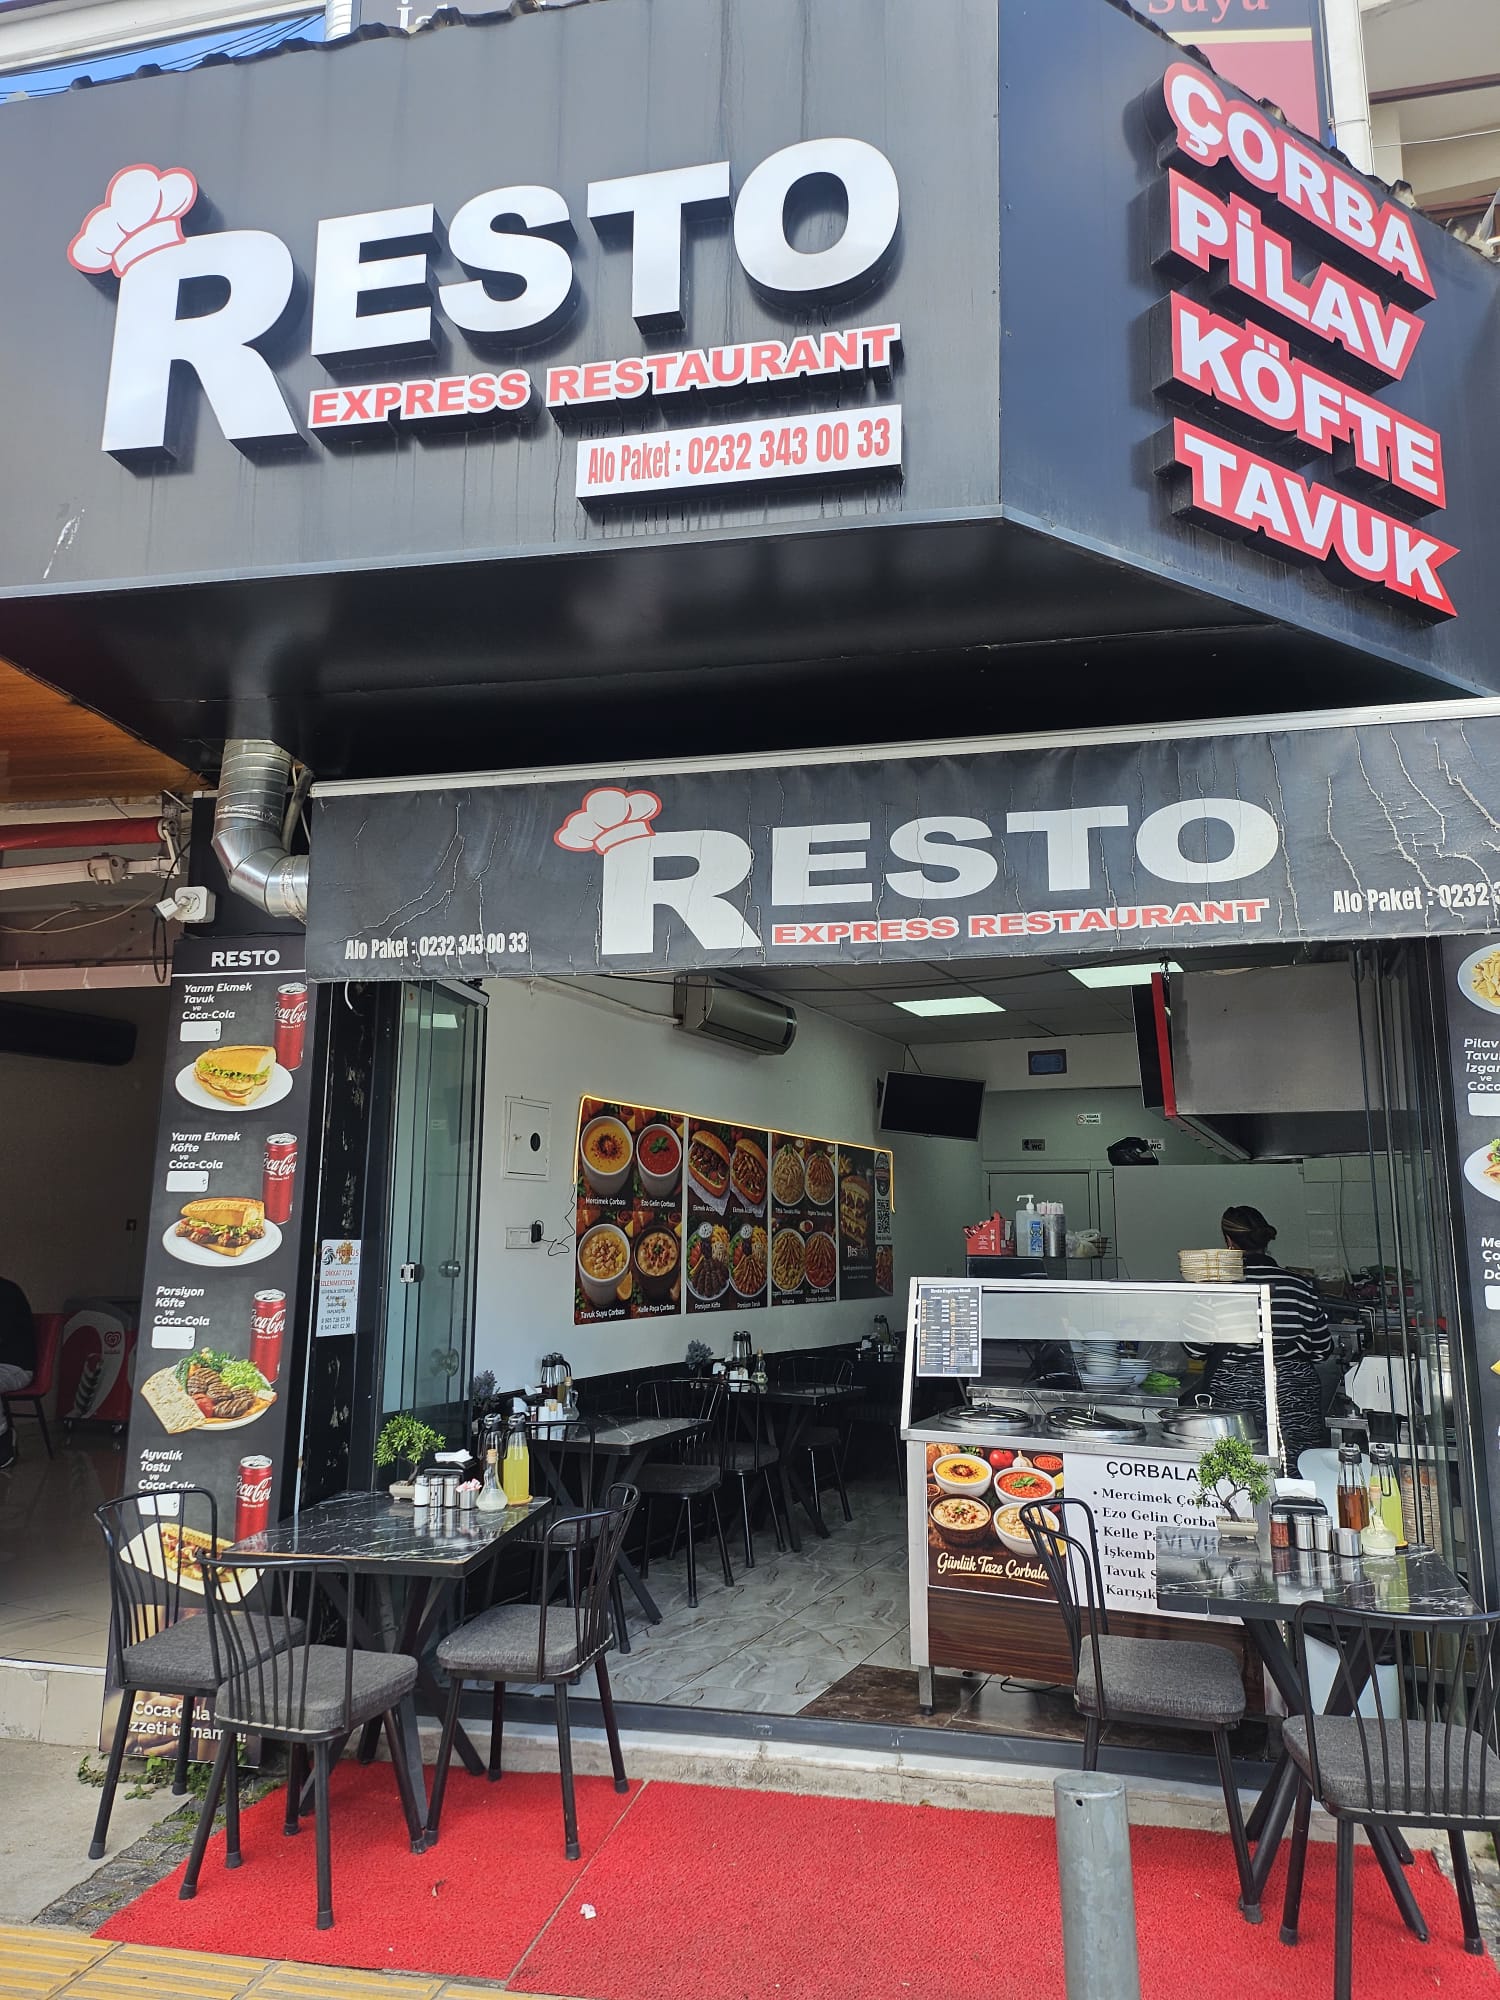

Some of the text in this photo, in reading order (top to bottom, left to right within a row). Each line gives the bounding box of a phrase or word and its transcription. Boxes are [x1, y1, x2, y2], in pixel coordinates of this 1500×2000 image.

[1170, 74, 1425, 284] ÇORBA
[1177, 186, 1412, 371] PİLAV
[102, 138, 900, 453] RESTO
[310, 325, 900, 428] EXPRESS RESTAURANT
[1180, 308, 1439, 494] KÖFTE
[588, 447, 614, 485] Alo
[620, 440, 670, 482] Paket
[688, 432, 752, 475] 0232
[759, 427, 808, 468] 343
[816, 422, 849, 462] 00
[857, 417, 891, 458] 33
[1184, 433, 1445, 600] TAVUK
[601, 798, 1279, 955] RESTO
[1333, 889, 1362, 914] Alo
[1368, 886, 1422, 911] Paket
[1438, 882, 1490, 908] 0232
[772, 900, 1270, 946] EXPRESS RESTAURANT
[345, 939, 368, 961] Alo
[371, 937, 409, 959] Paket
[419, 936, 456, 958] 0232
[458, 934, 485, 956] 343
[486, 933, 506, 955] 00
[508, 932, 528, 953] 33
[211, 949, 280, 967] RESTO
[184, 982, 252, 994] Yarım Ekmek
[184, 994, 215, 1004] Tavuk
[182, 1009, 236, 1020] Coca-Cola
[1464, 1038, 1499, 1048] Pilav
[1465, 1050, 1500, 1061] Tavu
[172, 1131, 242, 1142] Yarım Ekmek
[169, 1143, 200, 1153] Köfte
[168, 1160, 224, 1170] Coca-Cola
[1481, 1237, 1500, 1248] Me
[1482, 1250, 1500, 1263] Ço
[156, 1286, 205, 1298] Porsiyon
[154, 1297, 186, 1308] Köfte
[154, 1316, 210, 1326] Coca-Cola
[140, 1449, 184, 1461] Ayvalık
[140, 1461, 171, 1473] Tostu
[1106, 1461, 1199, 1481] ÇORBALA
[1101, 1487, 1225, 1510] Mercimek Çobas
[1102, 1507, 1216, 1527] Ezo Gelin Çorba
[1103, 1526, 1156, 1541] Kelle Pa
[1103, 1543, 1155, 1560] İşkemb
[937, 1552, 1049, 1580] Günlük Taze Çorbala
[1104, 1564, 1157, 1580] Tavuk S
[133, 1700, 211, 1721] Coca-Cla
[129, 1720, 168, 1736] zzeti
